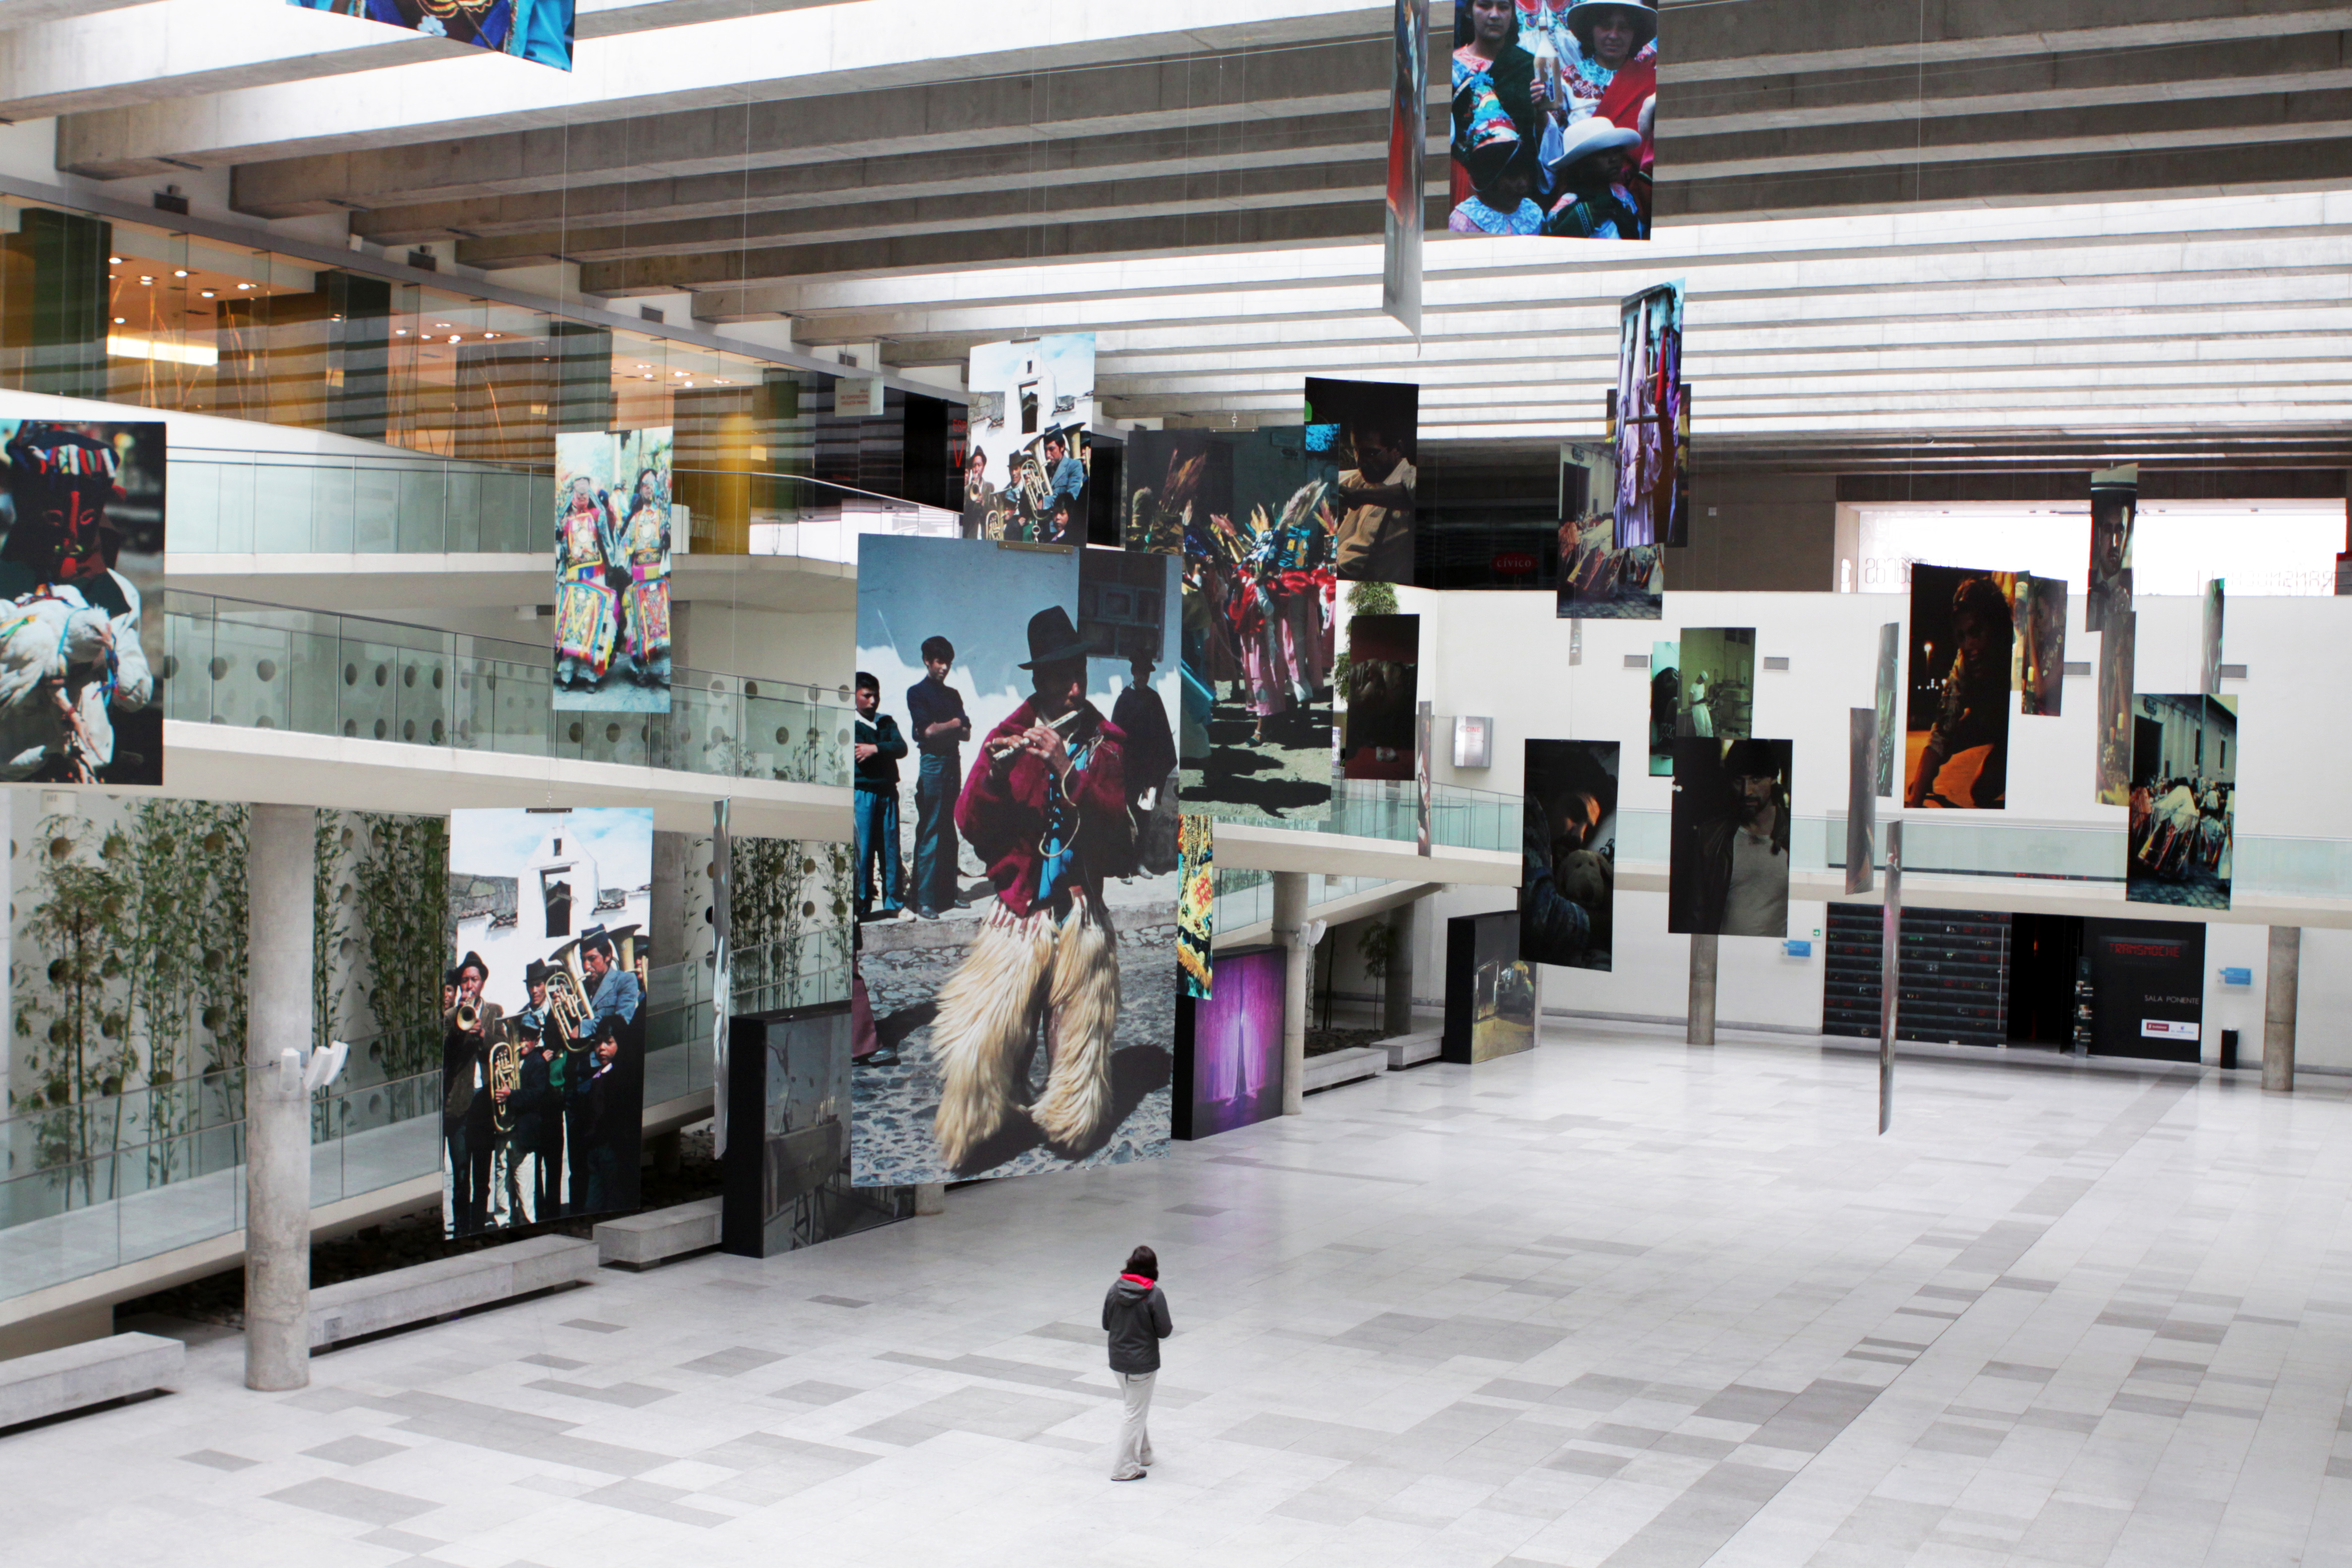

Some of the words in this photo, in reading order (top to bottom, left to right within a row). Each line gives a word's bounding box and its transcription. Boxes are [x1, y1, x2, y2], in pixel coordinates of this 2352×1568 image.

[952, 419, 967, 433] ESP
[1497, 557, 1531, 567] cívico
[2109, 943, 2180, 957] TRANSNOCHE
[2166, 996, 2200, 1005] PONIENTE
